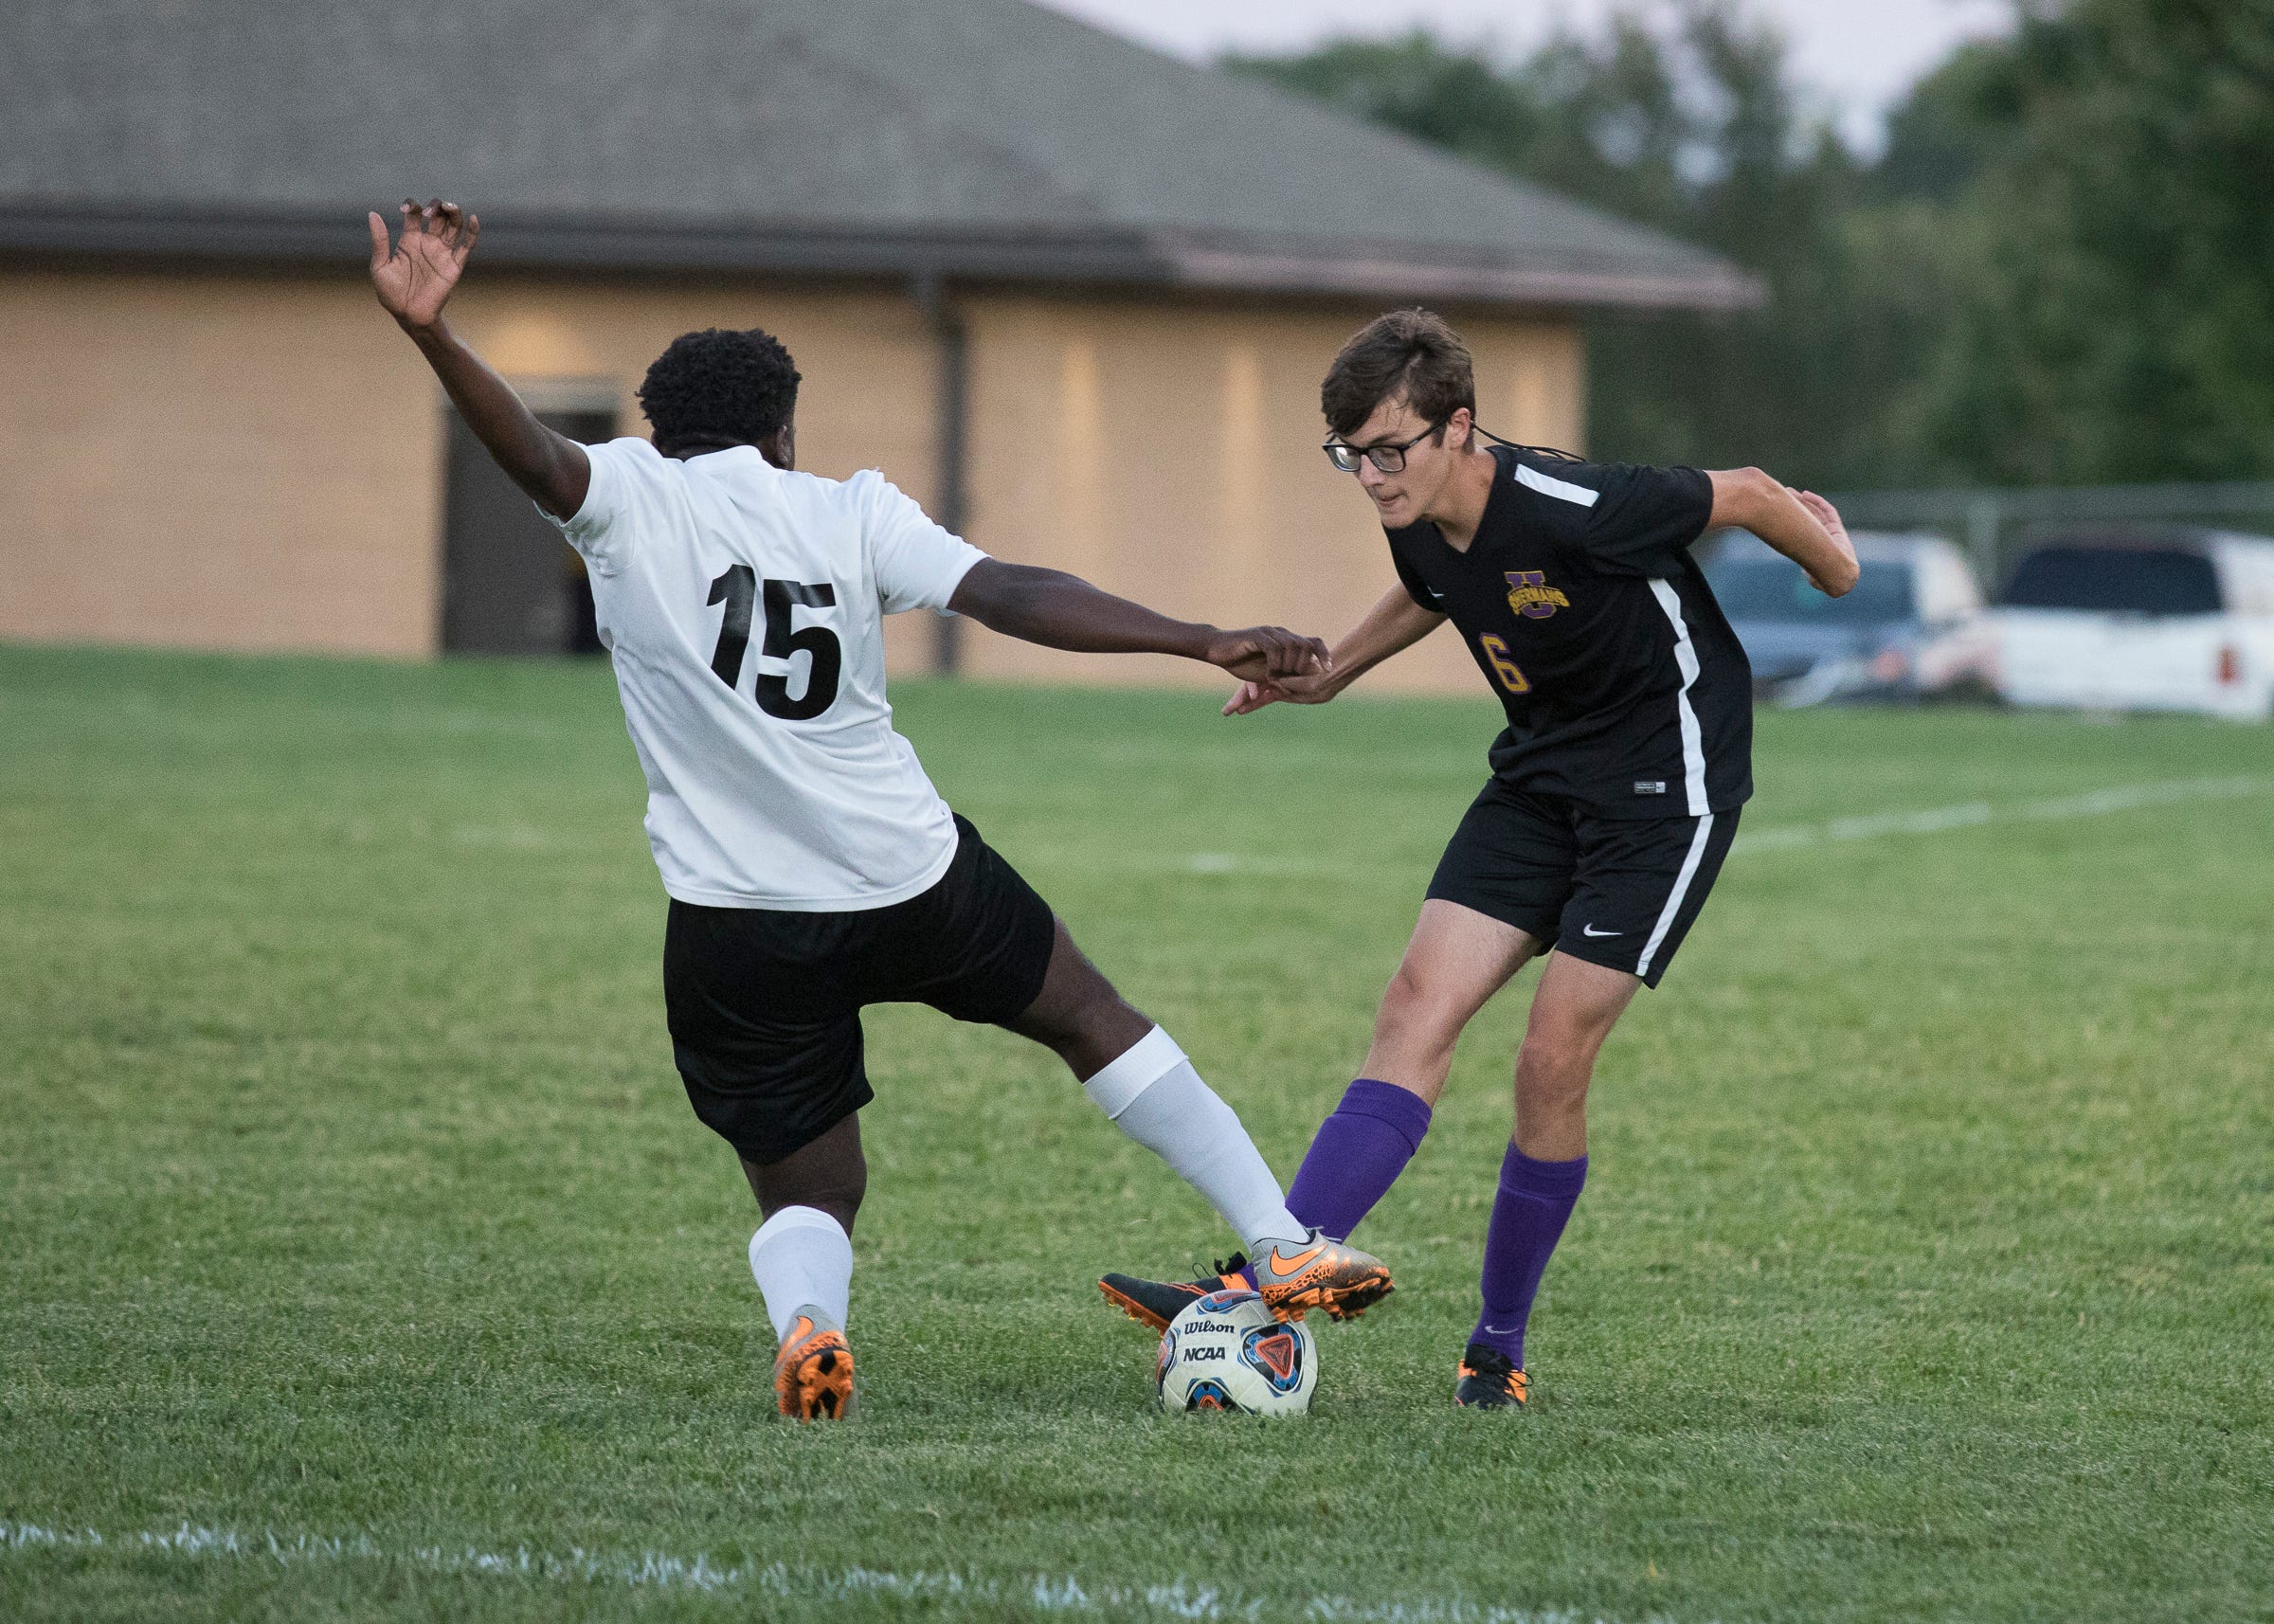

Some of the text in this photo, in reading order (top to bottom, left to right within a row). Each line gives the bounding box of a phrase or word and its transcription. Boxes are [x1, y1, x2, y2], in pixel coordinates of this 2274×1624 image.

[707, 564, 841, 720] 15
[1480, 632, 1531, 695] 6
[1184, 1320, 1235, 1335] Wilson
[1183, 1346, 1226, 1362] NCAA
